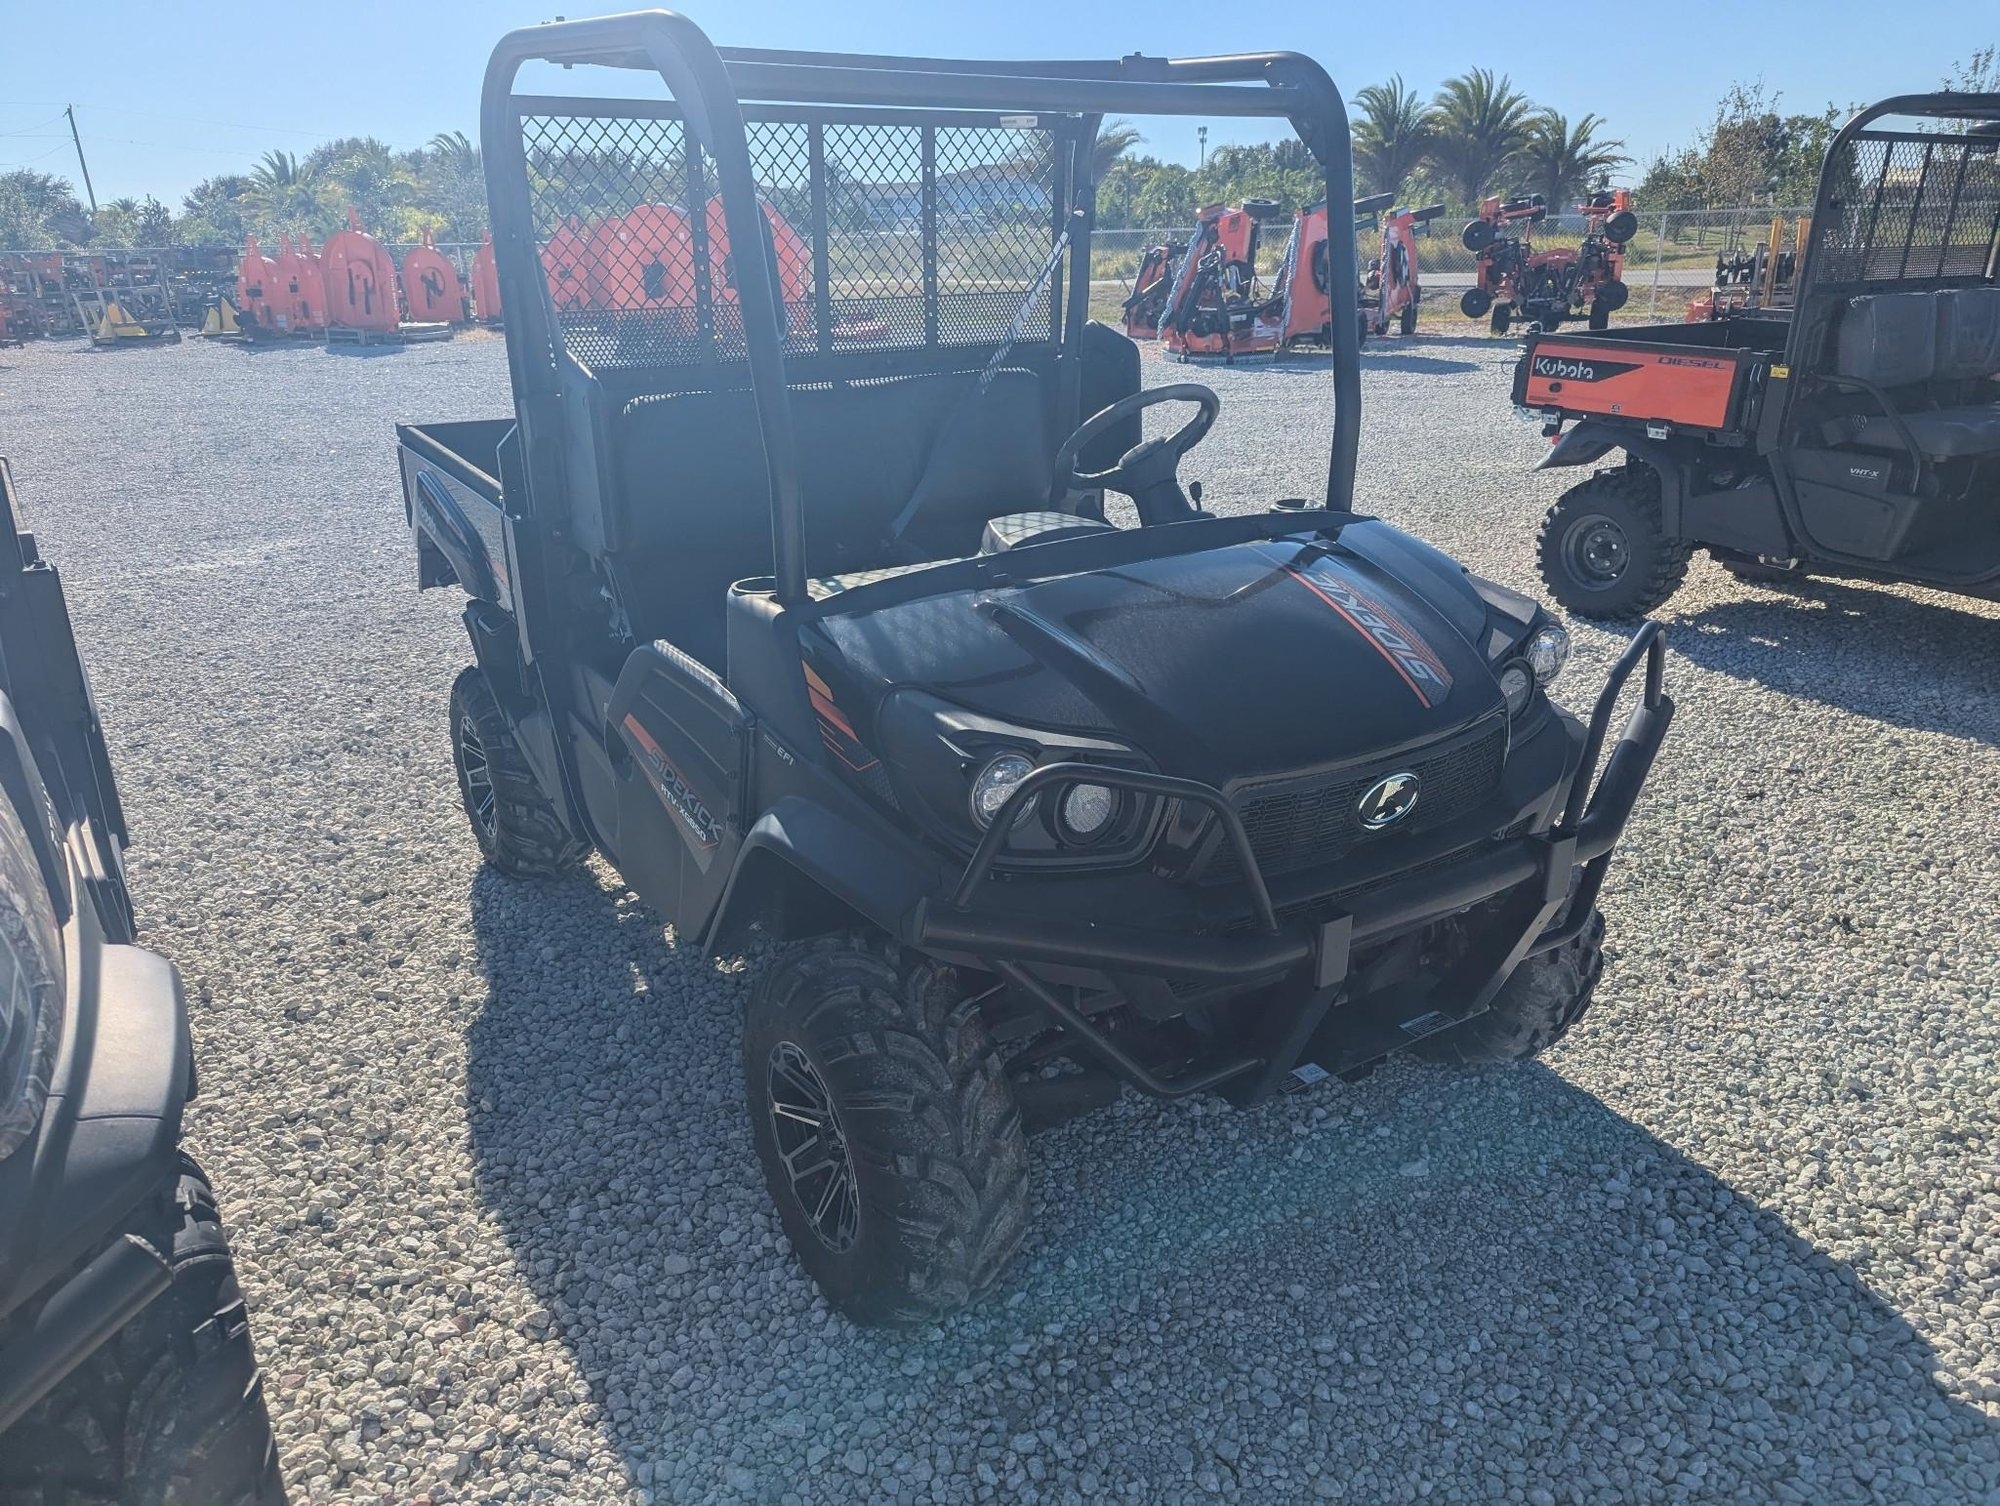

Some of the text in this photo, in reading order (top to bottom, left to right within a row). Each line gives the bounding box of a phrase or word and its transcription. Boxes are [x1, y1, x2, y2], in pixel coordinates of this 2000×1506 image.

[1535, 357, 1594, 380] Kubota
[1658, 356, 1726, 370] DIESEL
[1301, 568, 1446, 687] SIDEKIC
[777, 746, 794, 766] EFI
[648, 747, 723, 841] SIDEKICK
